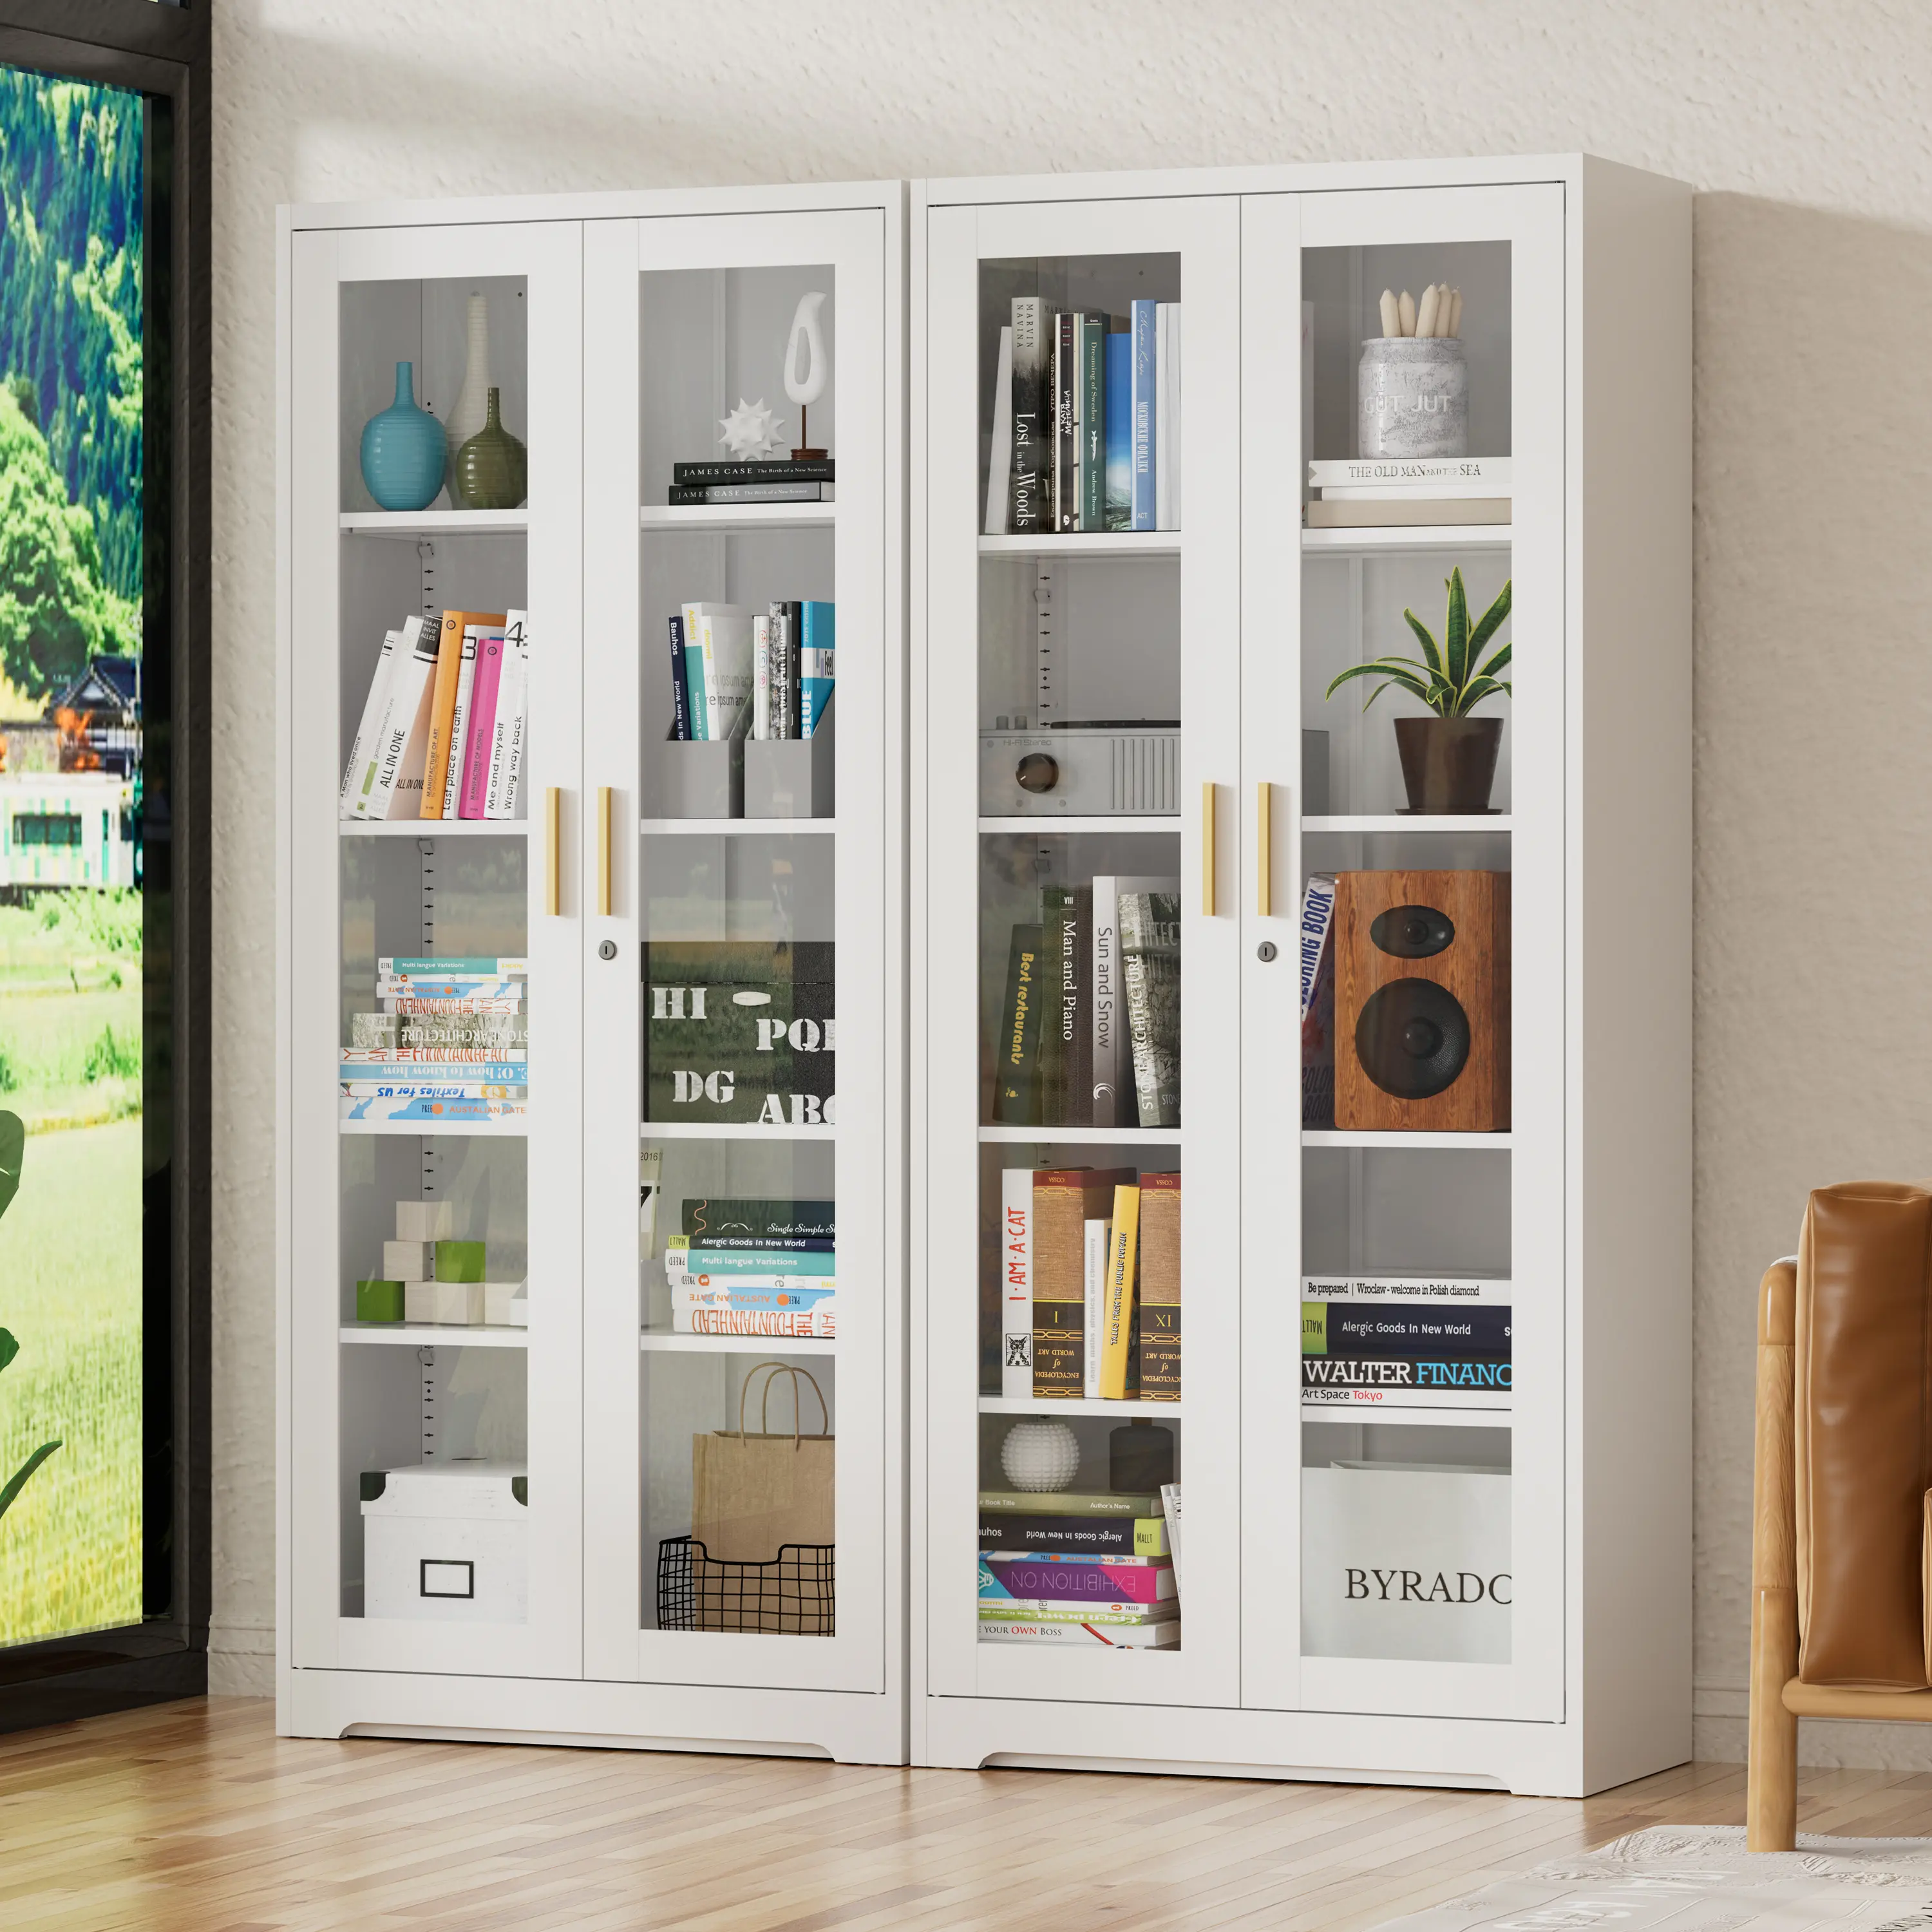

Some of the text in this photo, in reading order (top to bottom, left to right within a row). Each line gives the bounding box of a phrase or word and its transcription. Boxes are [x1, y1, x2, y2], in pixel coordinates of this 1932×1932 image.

[1091, 382, 1097, 390] of
[1137, 401, 1148, 442] МОСКОВСКИЕ
[683, 468, 719, 477] JAMES
[1016, 413, 1036, 526] Lost in the Woods
[1349, 464, 1481, 478] THE OLD MAN SEA
[677, 491, 710, 499] JAMES
[424, 620, 439, 629] MAAL
[421, 633, 435, 641] ALLES
[670, 622, 679, 656] Bauhos
[802, 690, 811, 739] BLUE
[380, 728, 405, 788] ALL IN ONE
[443, 705, 462, 810] Last place on earth
[488, 791, 496, 810] Me
[495, 723, 504, 760] myself
[504, 716, 522, 810] Wrong way back
[395, 779, 406, 789] ALL
[426, 751, 435, 797] MANUFACTURE
[470, 759, 479, 800] MANUFACTURE
[1302, 889, 1332, 934] BOOK
[1063, 920, 1076, 1041] Man and Piano
[1098, 927, 1113, 1048] Sun and Snow
[395, 998, 461, 1015] FOUNTAINHEAD
[652, 987, 707, 1019] HI
[1011, 953, 1034, 1065] Best restaurants
[1127, 954, 1148, 1057] ARCHITECTURE
[401, 1029, 487, 1042] ARCHITECTURE
[381, 1066, 493, 1079] how know how
[397, 1087, 465, 1097] Textiles for
[672, 1070, 735, 1103] DG
[767, 1223, 824, 1234] Single Simple
[701, 1238, 727, 1247] Alergic
[1117, 1232, 1127, 1259] DOMAIN
[724, 1257, 753, 1267] langue
[1115, 1260, 1124, 1285] PUBLIC
[1308, 1282, 1480, 1296] Be prepared Wroclaw welcome Polish diamond
[692, 1309, 794, 1337] FOUNTAINHEAD
[797, 1311, 813, 1337] THE
[1110, 1322, 1119, 1345] TALES
[1342, 1321, 1471, 1336] Alergic Goods In New World
[1303, 1360, 1412, 1385] WALTER
[1302, 1389, 1383, 1402] Art Space Tokyo
[1099, 1531, 1122, 1542] Alergic
[1137, 1533, 1153, 1544] MALLT
[1011, 1570, 1135, 1593] EXHIBITION ON
[1012, 1626, 1037, 1634] OWN
